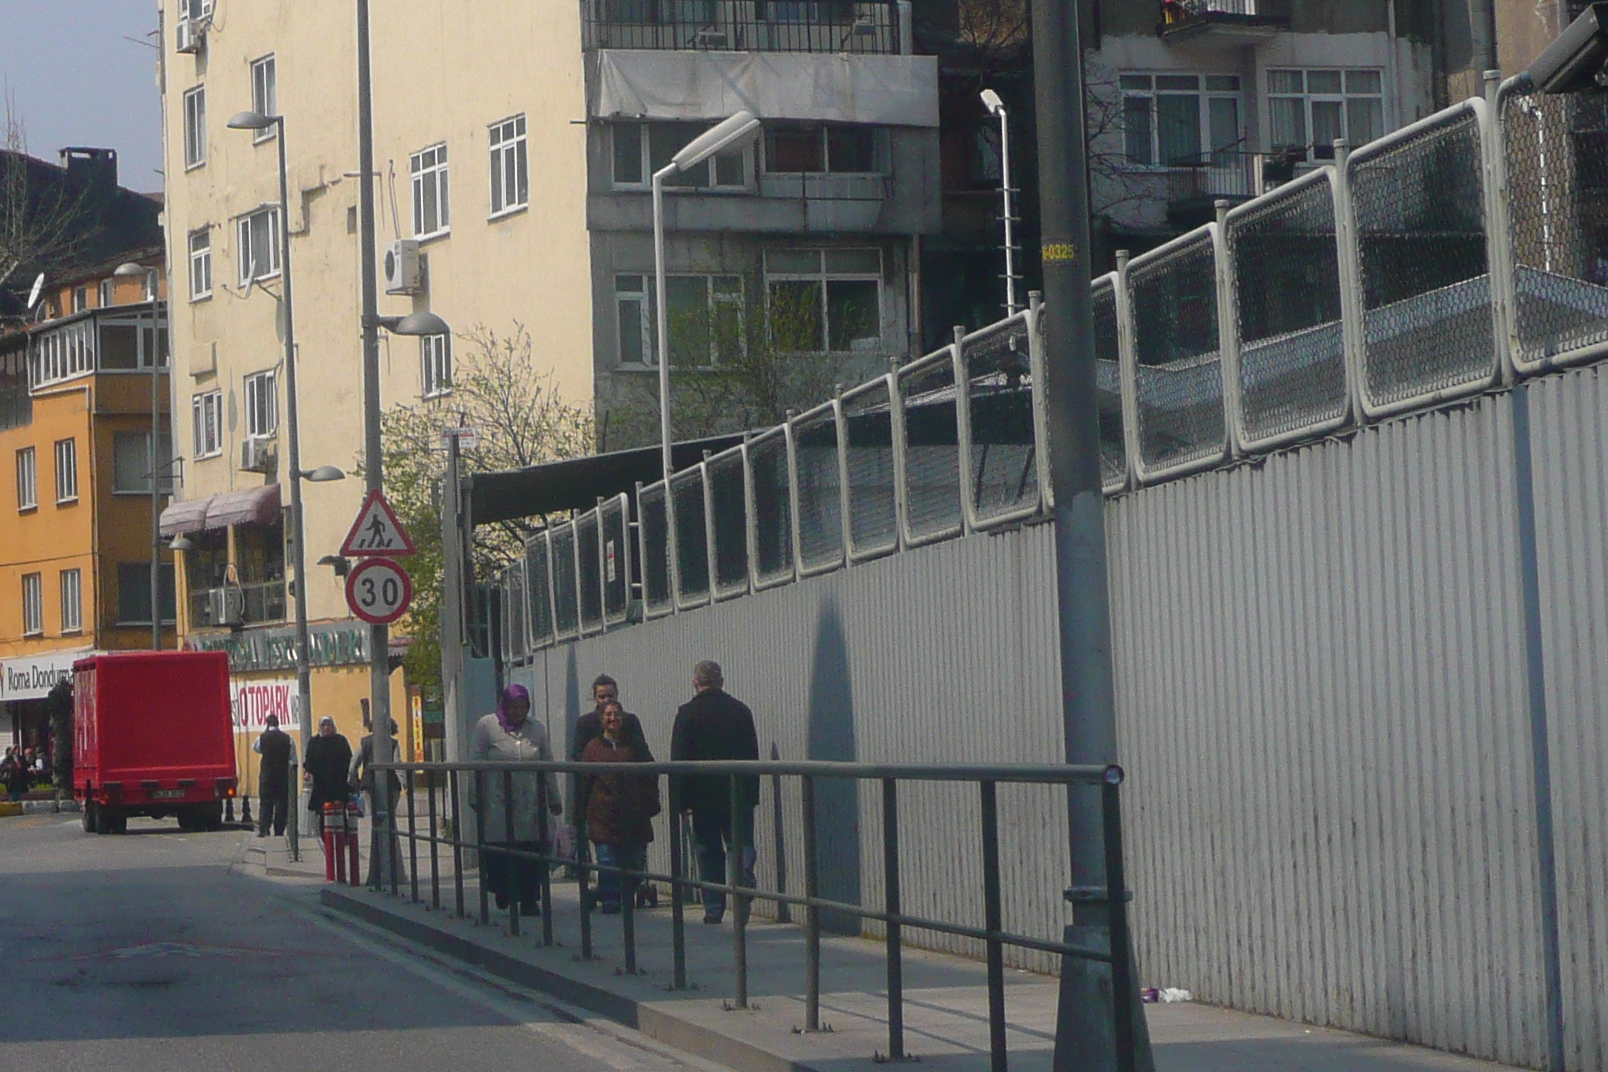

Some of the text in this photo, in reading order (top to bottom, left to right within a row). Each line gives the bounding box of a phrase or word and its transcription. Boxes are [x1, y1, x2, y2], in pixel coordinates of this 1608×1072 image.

[361, 578, 399, 607] 30
[8, 666, 31, 691] Roma
[239, 685, 291, 727] OTOPARK
